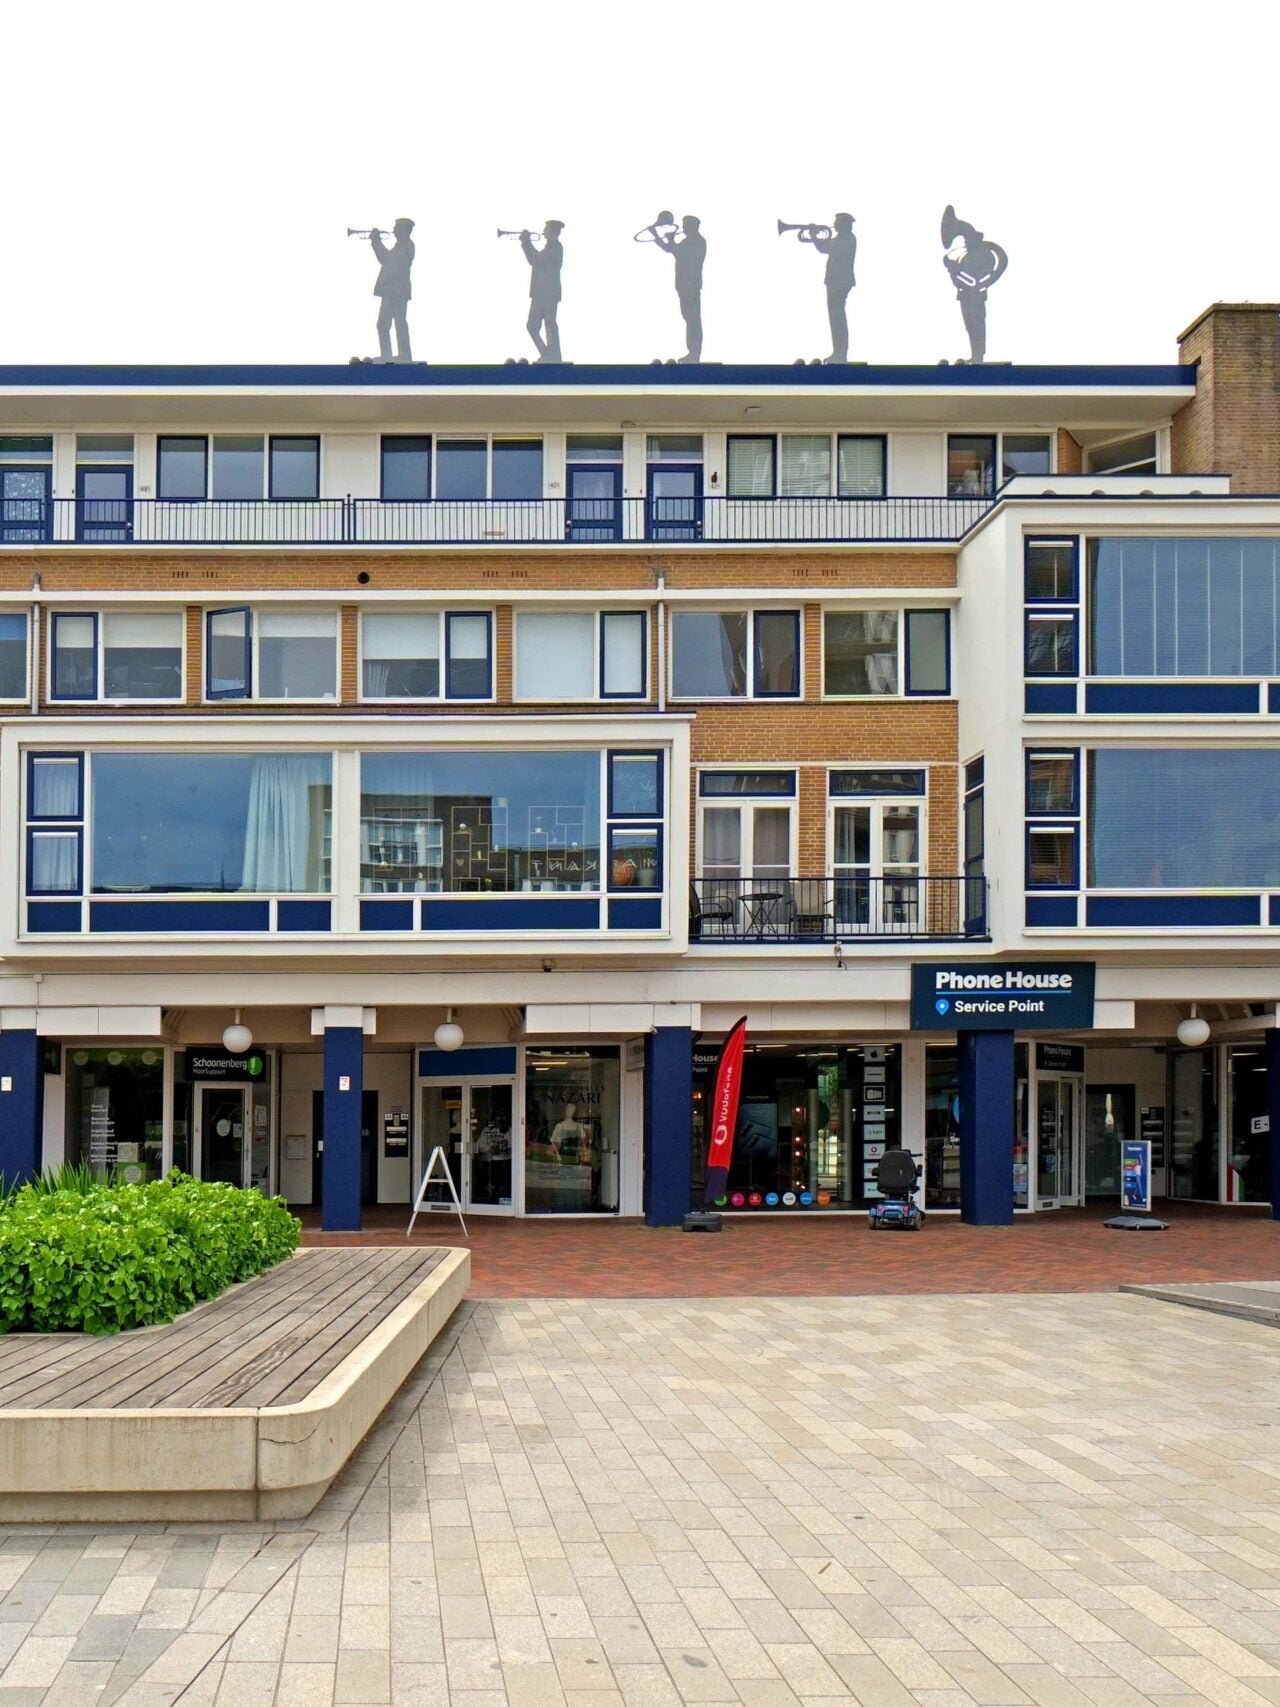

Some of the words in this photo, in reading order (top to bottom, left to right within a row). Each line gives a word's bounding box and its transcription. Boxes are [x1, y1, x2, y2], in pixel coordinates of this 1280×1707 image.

[936, 972, 1004, 989] Phone
[1005, 971, 1072, 988] House
[954, 1000, 1005, 1013] Service
[1008, 999, 1044, 1012] Point
[193, 1057, 247, 1071] Schoonenberg
